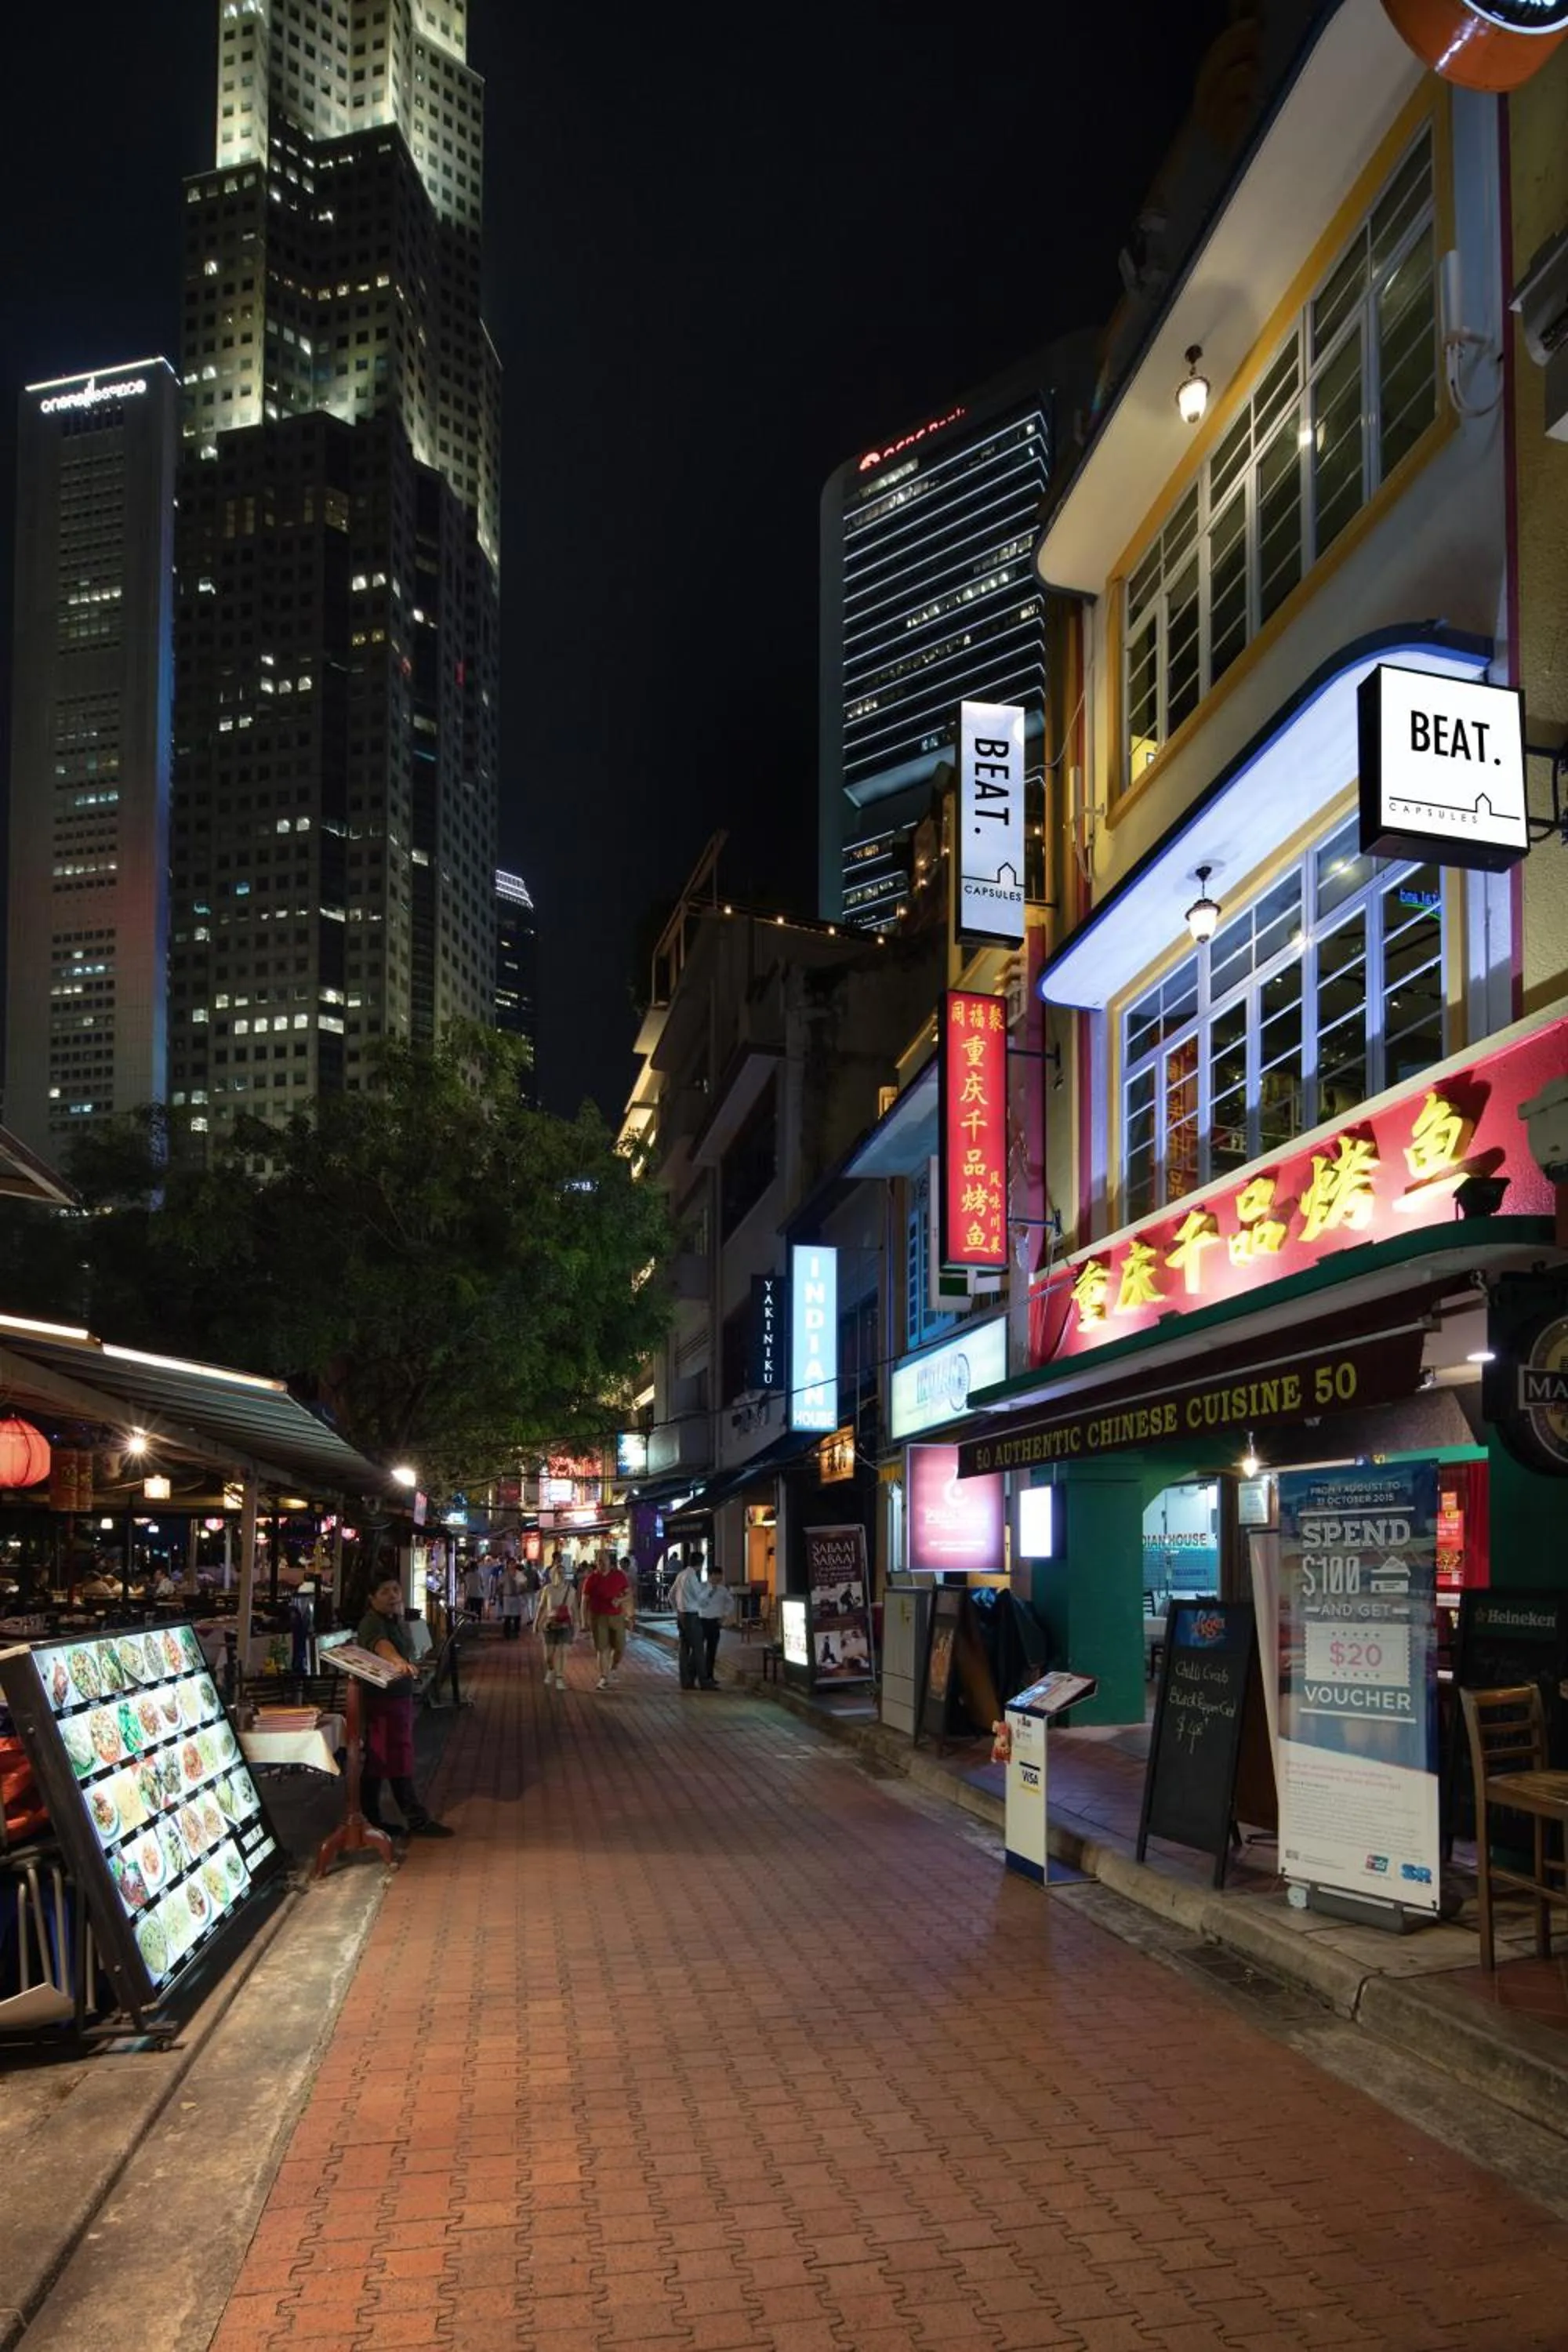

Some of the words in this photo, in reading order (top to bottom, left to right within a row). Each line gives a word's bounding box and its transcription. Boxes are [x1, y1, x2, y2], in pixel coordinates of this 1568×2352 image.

[1410, 710, 1501, 766] BEAT.
[975, 737, 1010, 835] BEAT.
[1388, 802, 1478, 824] CAPSULES
[964, 884, 1022, 902] CAPSULES
[960, 1034, 990, 1254] 重庆千品烤鱼
[1069, 1092, 1472, 1333] 重庆千品烤鱼
[763, 1279, 775, 1385] YAKINIKU
[804, 1254, 826, 1406] INDIAN
[795, 1411, 835, 1426] HOUSE
[976, 1449, 991, 1471] 50
[994, 1428, 1081, 1467] AUTHENTIC
[1087, 1402, 1178, 1450] CHINESE
[1185, 1374, 1303, 1428] CUISINE
[1314, 1362, 1358, 1404] 50
[1327, 1494, 1371, 1505] OCTOBER
[1372, 1492, 1395, 1503] 2015
[1343, 1482, 1383, 1493] AUGUST
[1388, 1480, 1401, 1490] TO
[1168, 1533, 1207, 1546] HOUSE
[1301, 1518, 1411, 1549] SPEND
[1301, 1554, 1360, 1597] $100
[1319, 1602, 1352, 1617] AND
[1358, 1603, 1392, 1617] GET
[1487, 1609, 1556, 1628] Heineken
[1329, 1641, 1382, 1668] $20
[1304, 1684, 1411, 1711] VOUCHER
[1022, 1769, 1039, 1786] VISA
